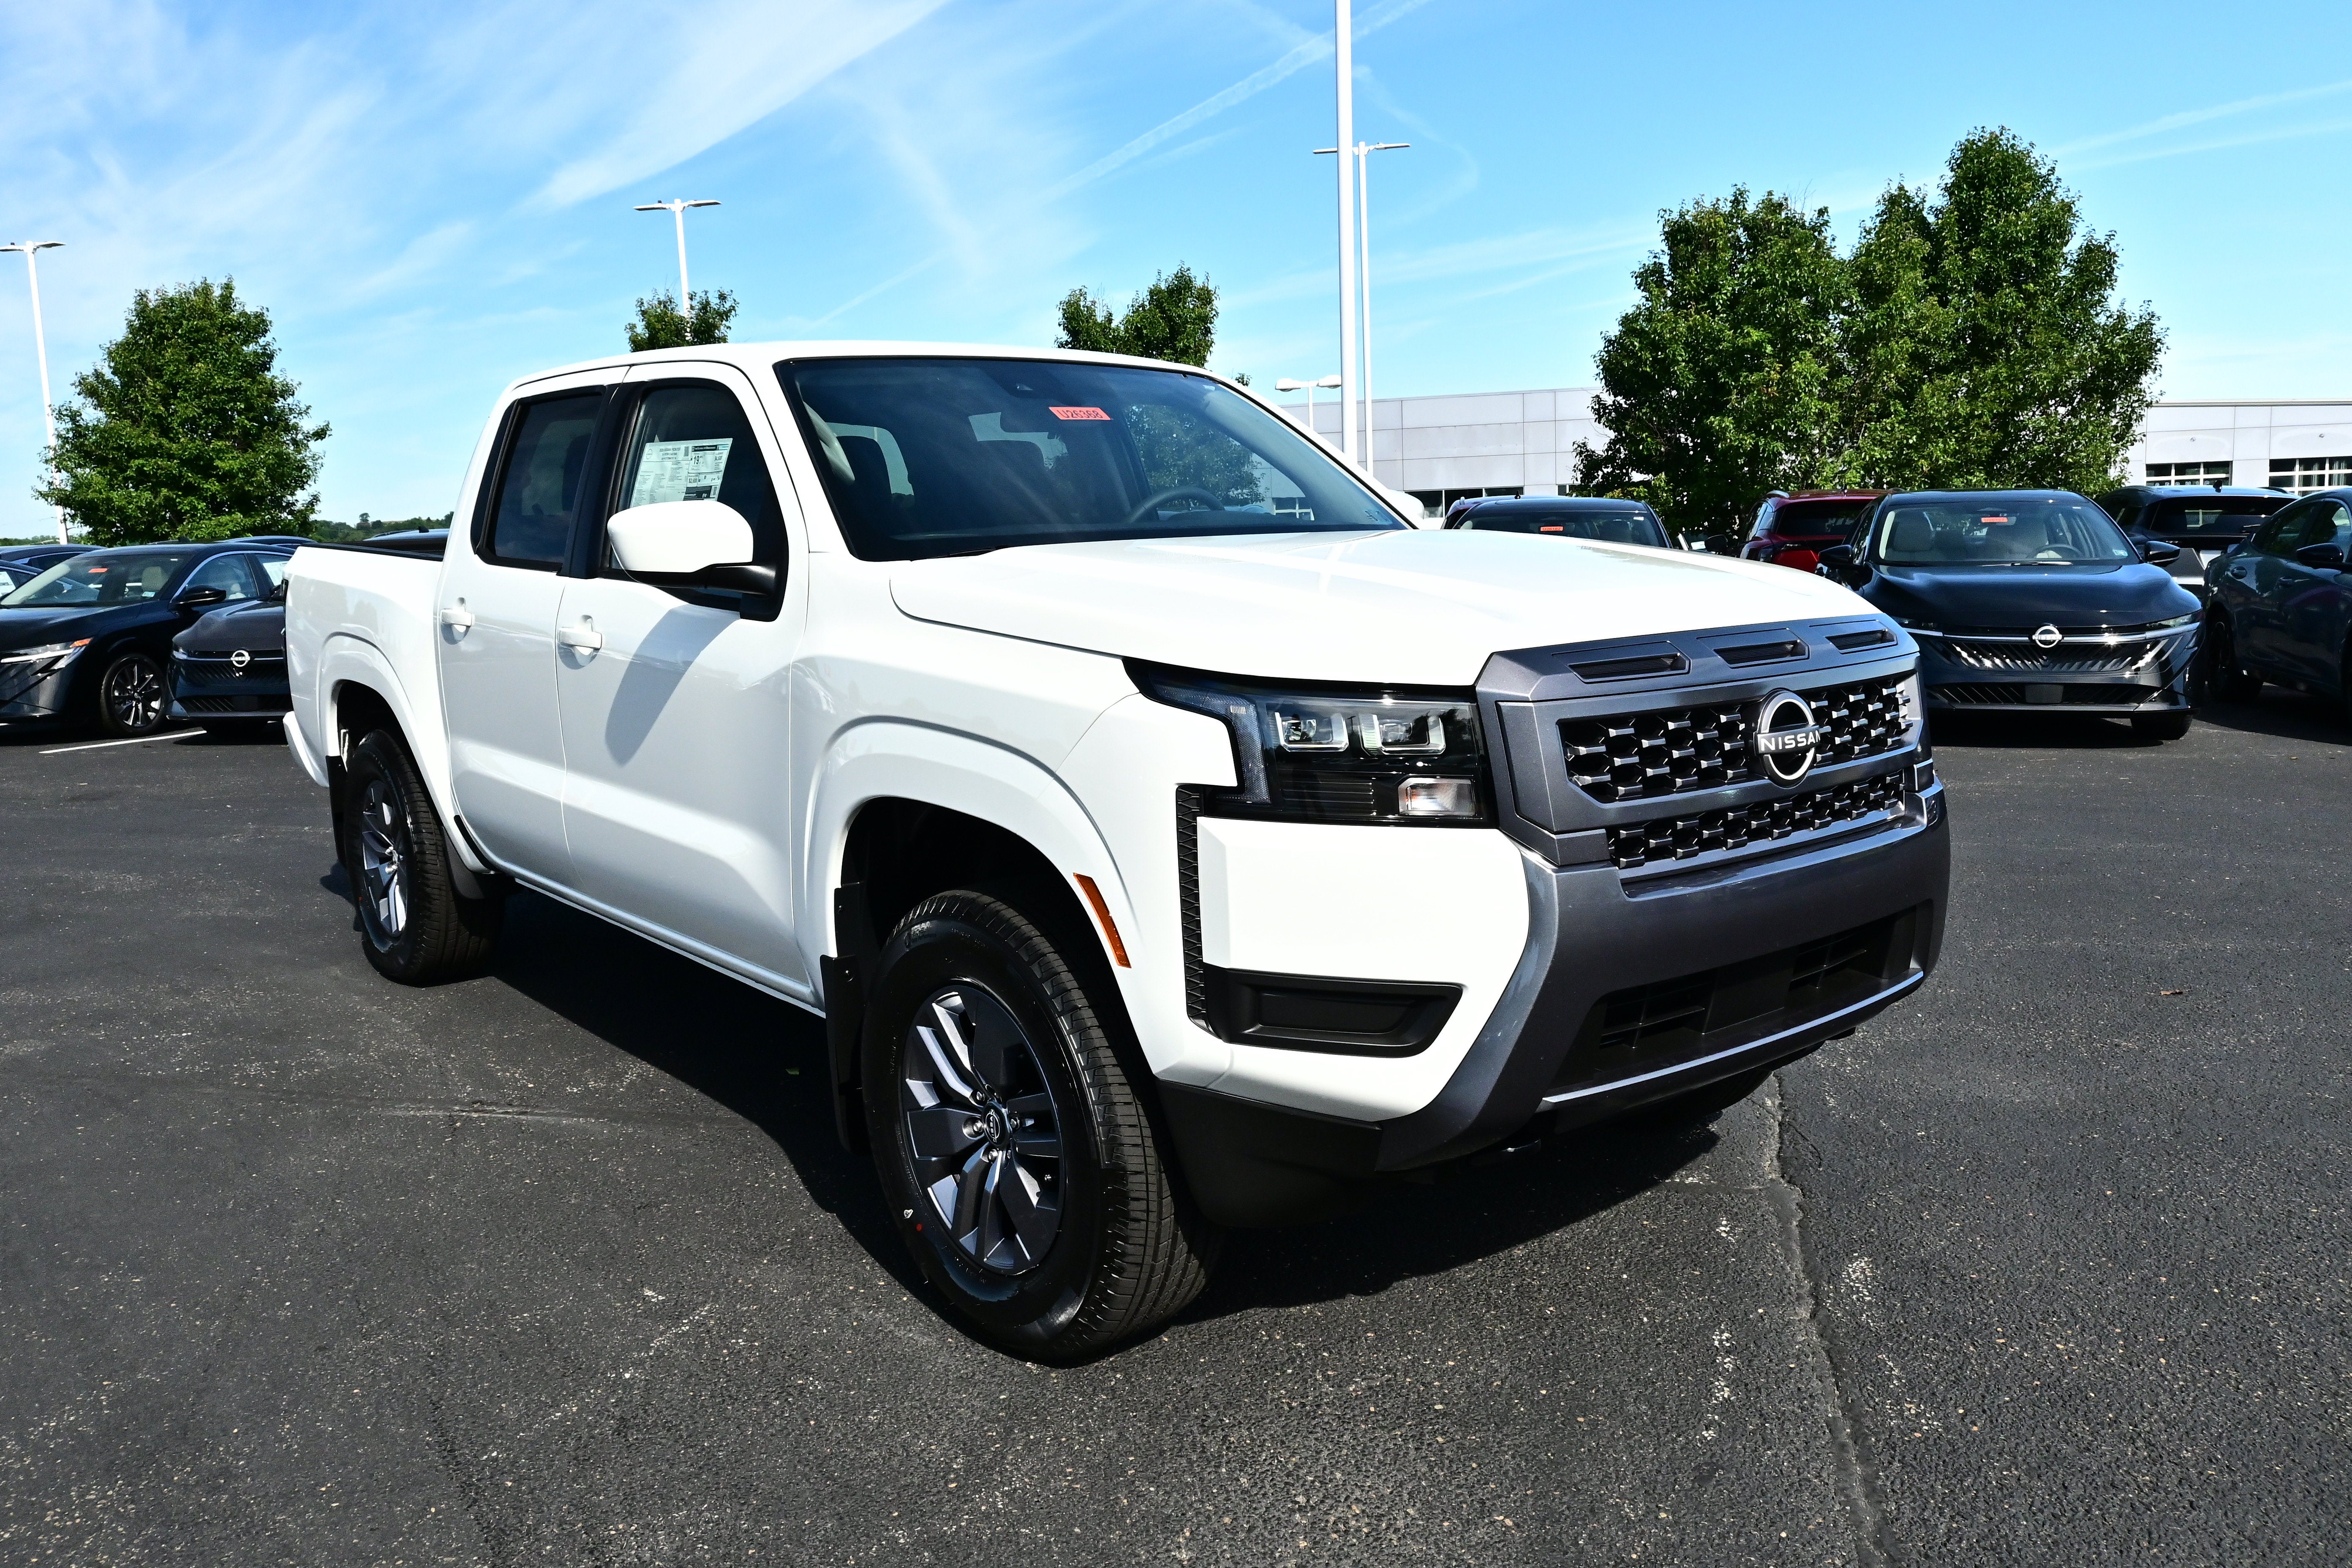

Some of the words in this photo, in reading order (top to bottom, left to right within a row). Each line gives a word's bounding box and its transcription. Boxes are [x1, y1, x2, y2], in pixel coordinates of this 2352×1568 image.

[1056, 410, 1103, 418] U26368
[694, 455, 700, 465] 19
[1760, 730, 1821, 751] NISSAN
